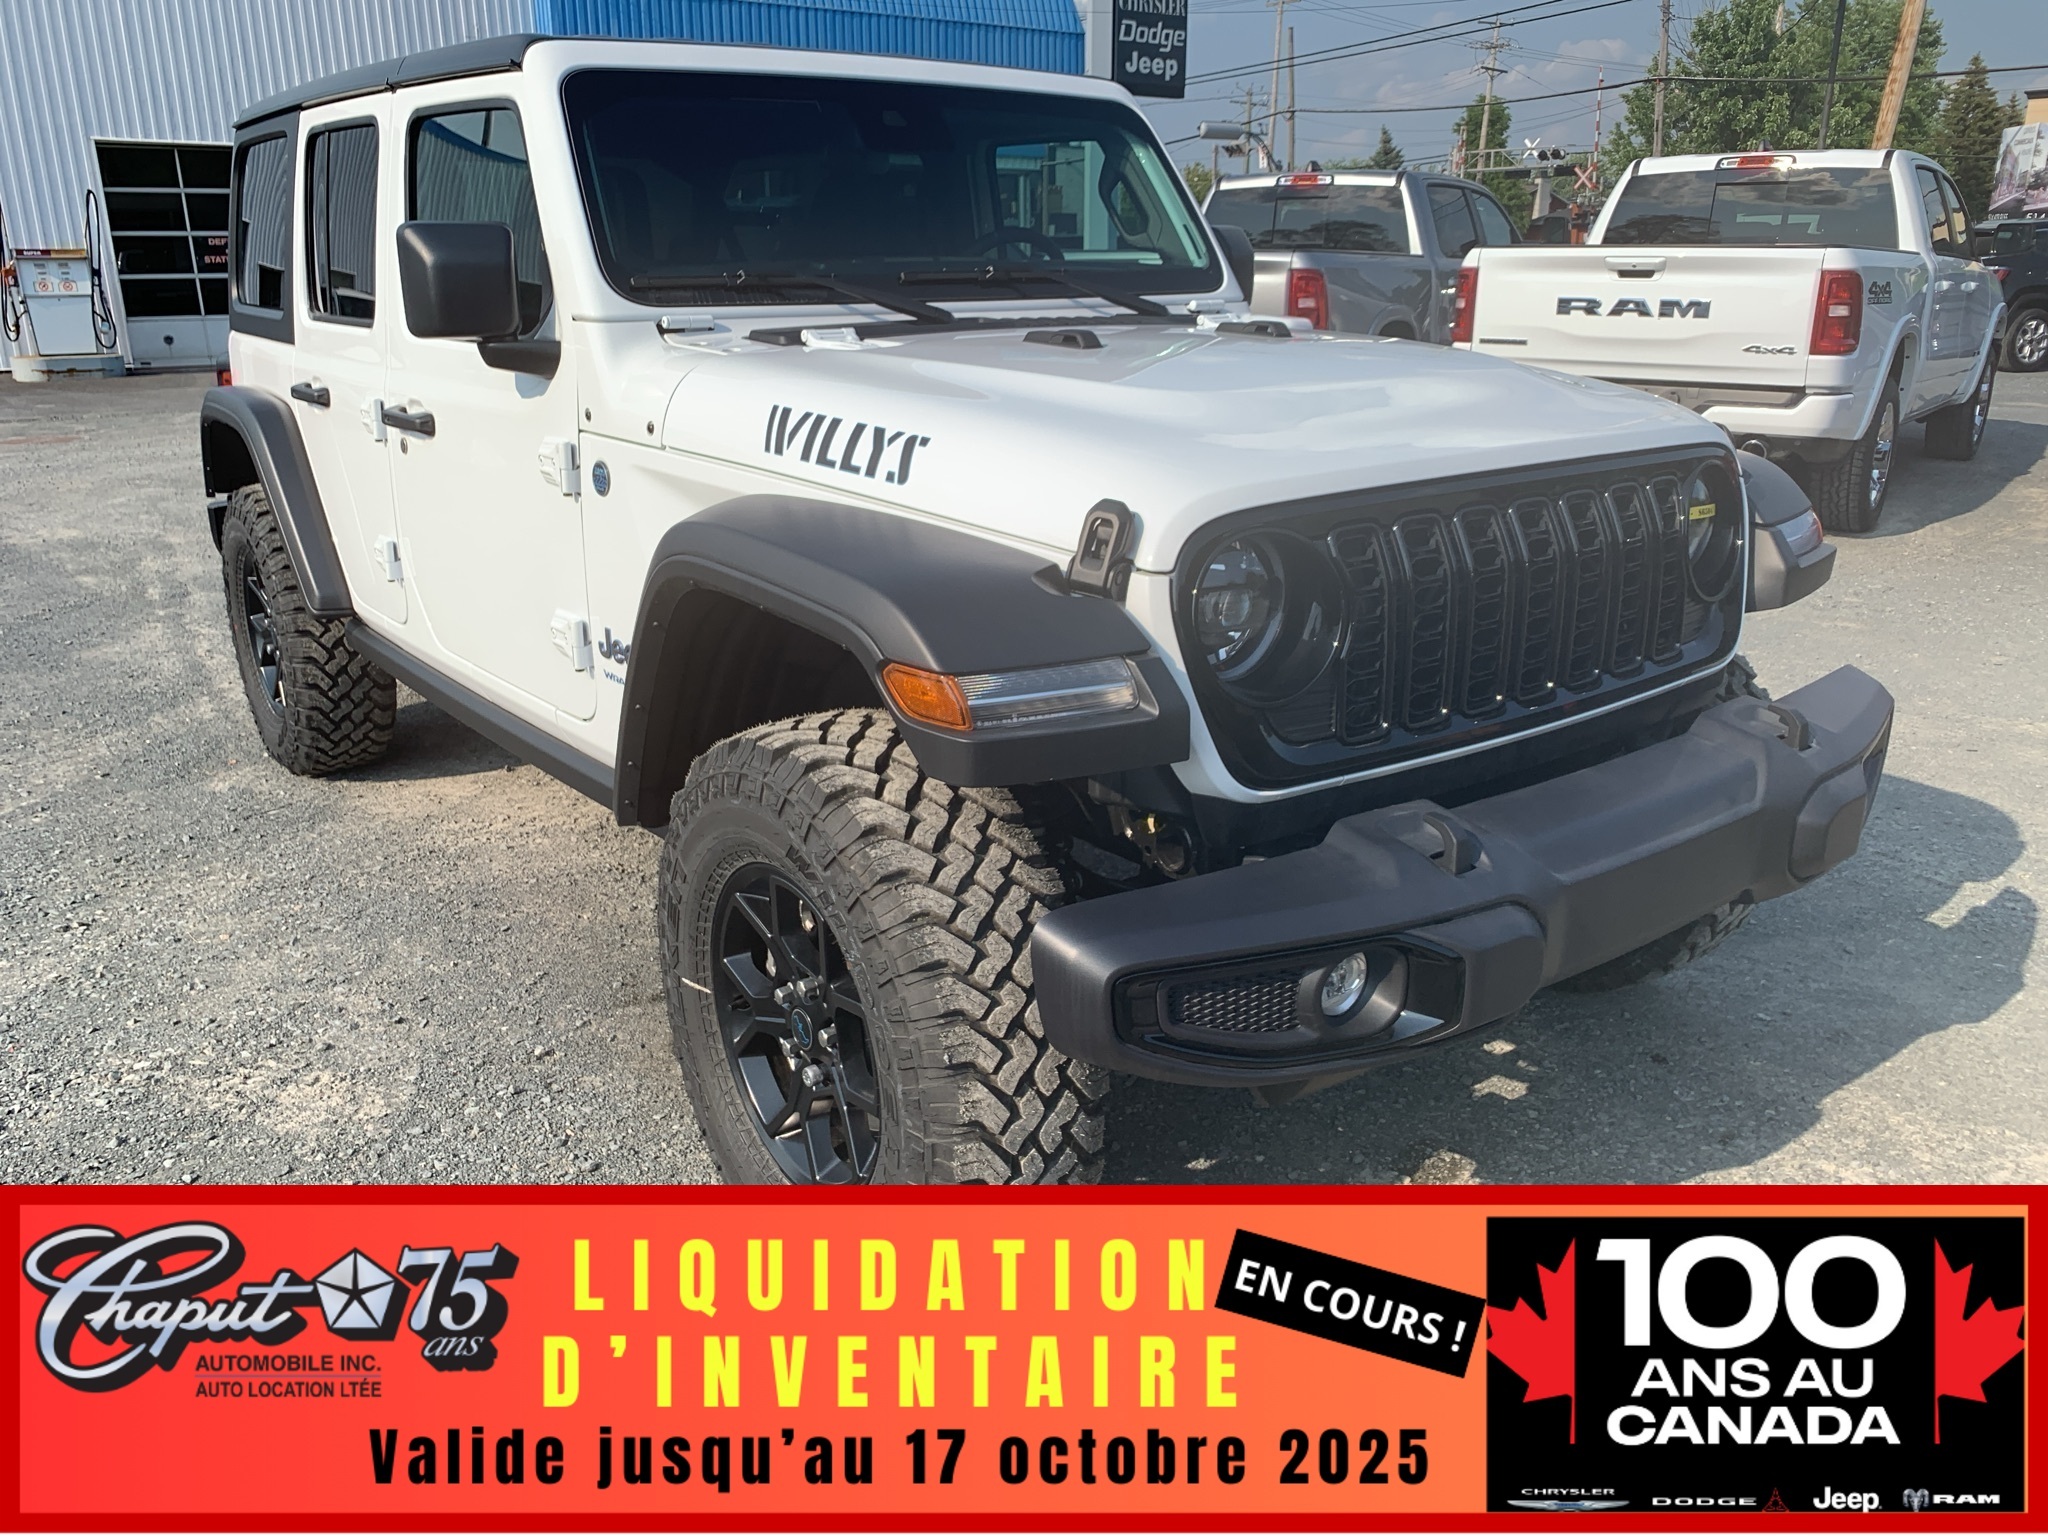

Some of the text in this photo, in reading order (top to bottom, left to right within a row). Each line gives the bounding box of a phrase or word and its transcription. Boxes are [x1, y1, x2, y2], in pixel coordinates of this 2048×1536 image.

[1119, 19, 1186, 52] Dodge
[1125, 51, 1178, 81] Jeep
[1868, 281, 1892, 296] 4x4
[1556, 297, 1711, 319] RAM
[1742, 344, 1798, 356] 4x4
[764, 404, 932, 486] WILLYS
